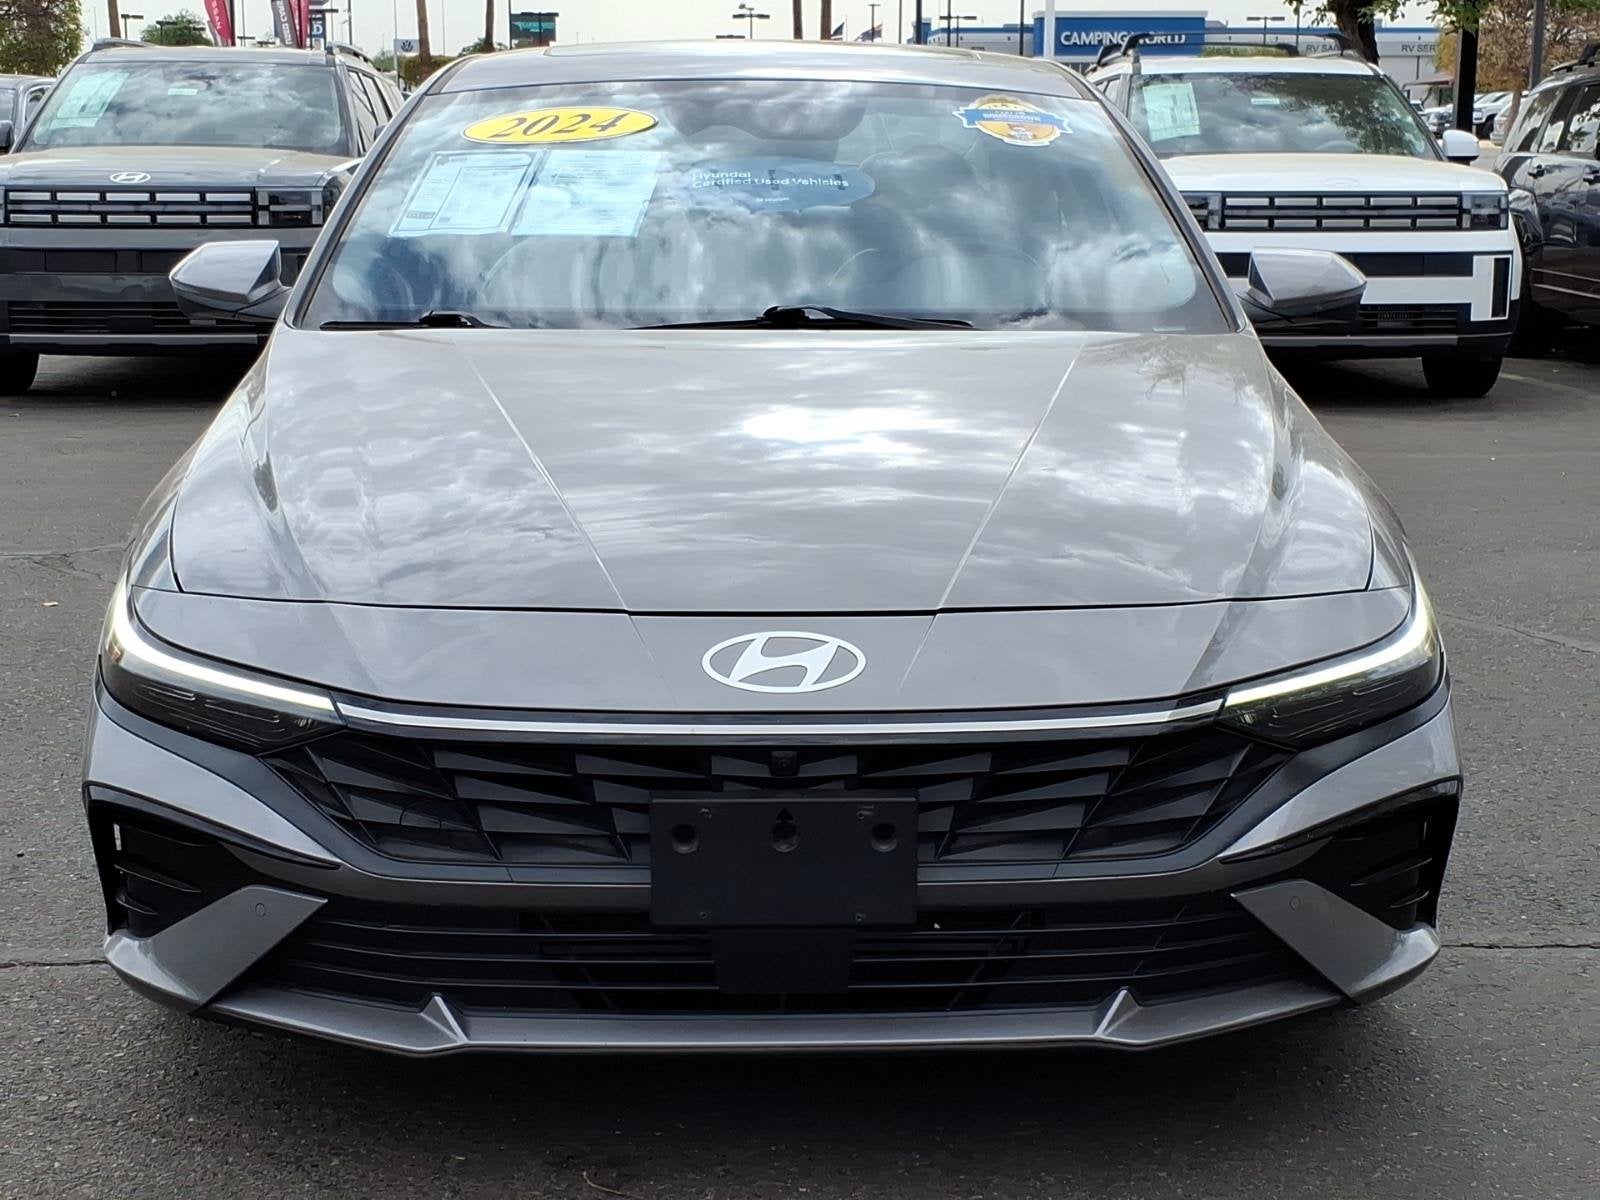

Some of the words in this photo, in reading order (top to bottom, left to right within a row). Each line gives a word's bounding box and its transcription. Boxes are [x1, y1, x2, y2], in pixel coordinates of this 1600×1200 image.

[1060, 31, 1129, 46] CAMPING
[1306, 44, 1320, 53] RV
[1401, 44, 1415, 52] RV
[486, 112, 631, 139] 2024
[692, 171, 751, 182] Hyundai
[692, 178, 751, 188] Certified
[754, 177, 789, 186] Used
[792, 177, 849, 187] Vehicles
